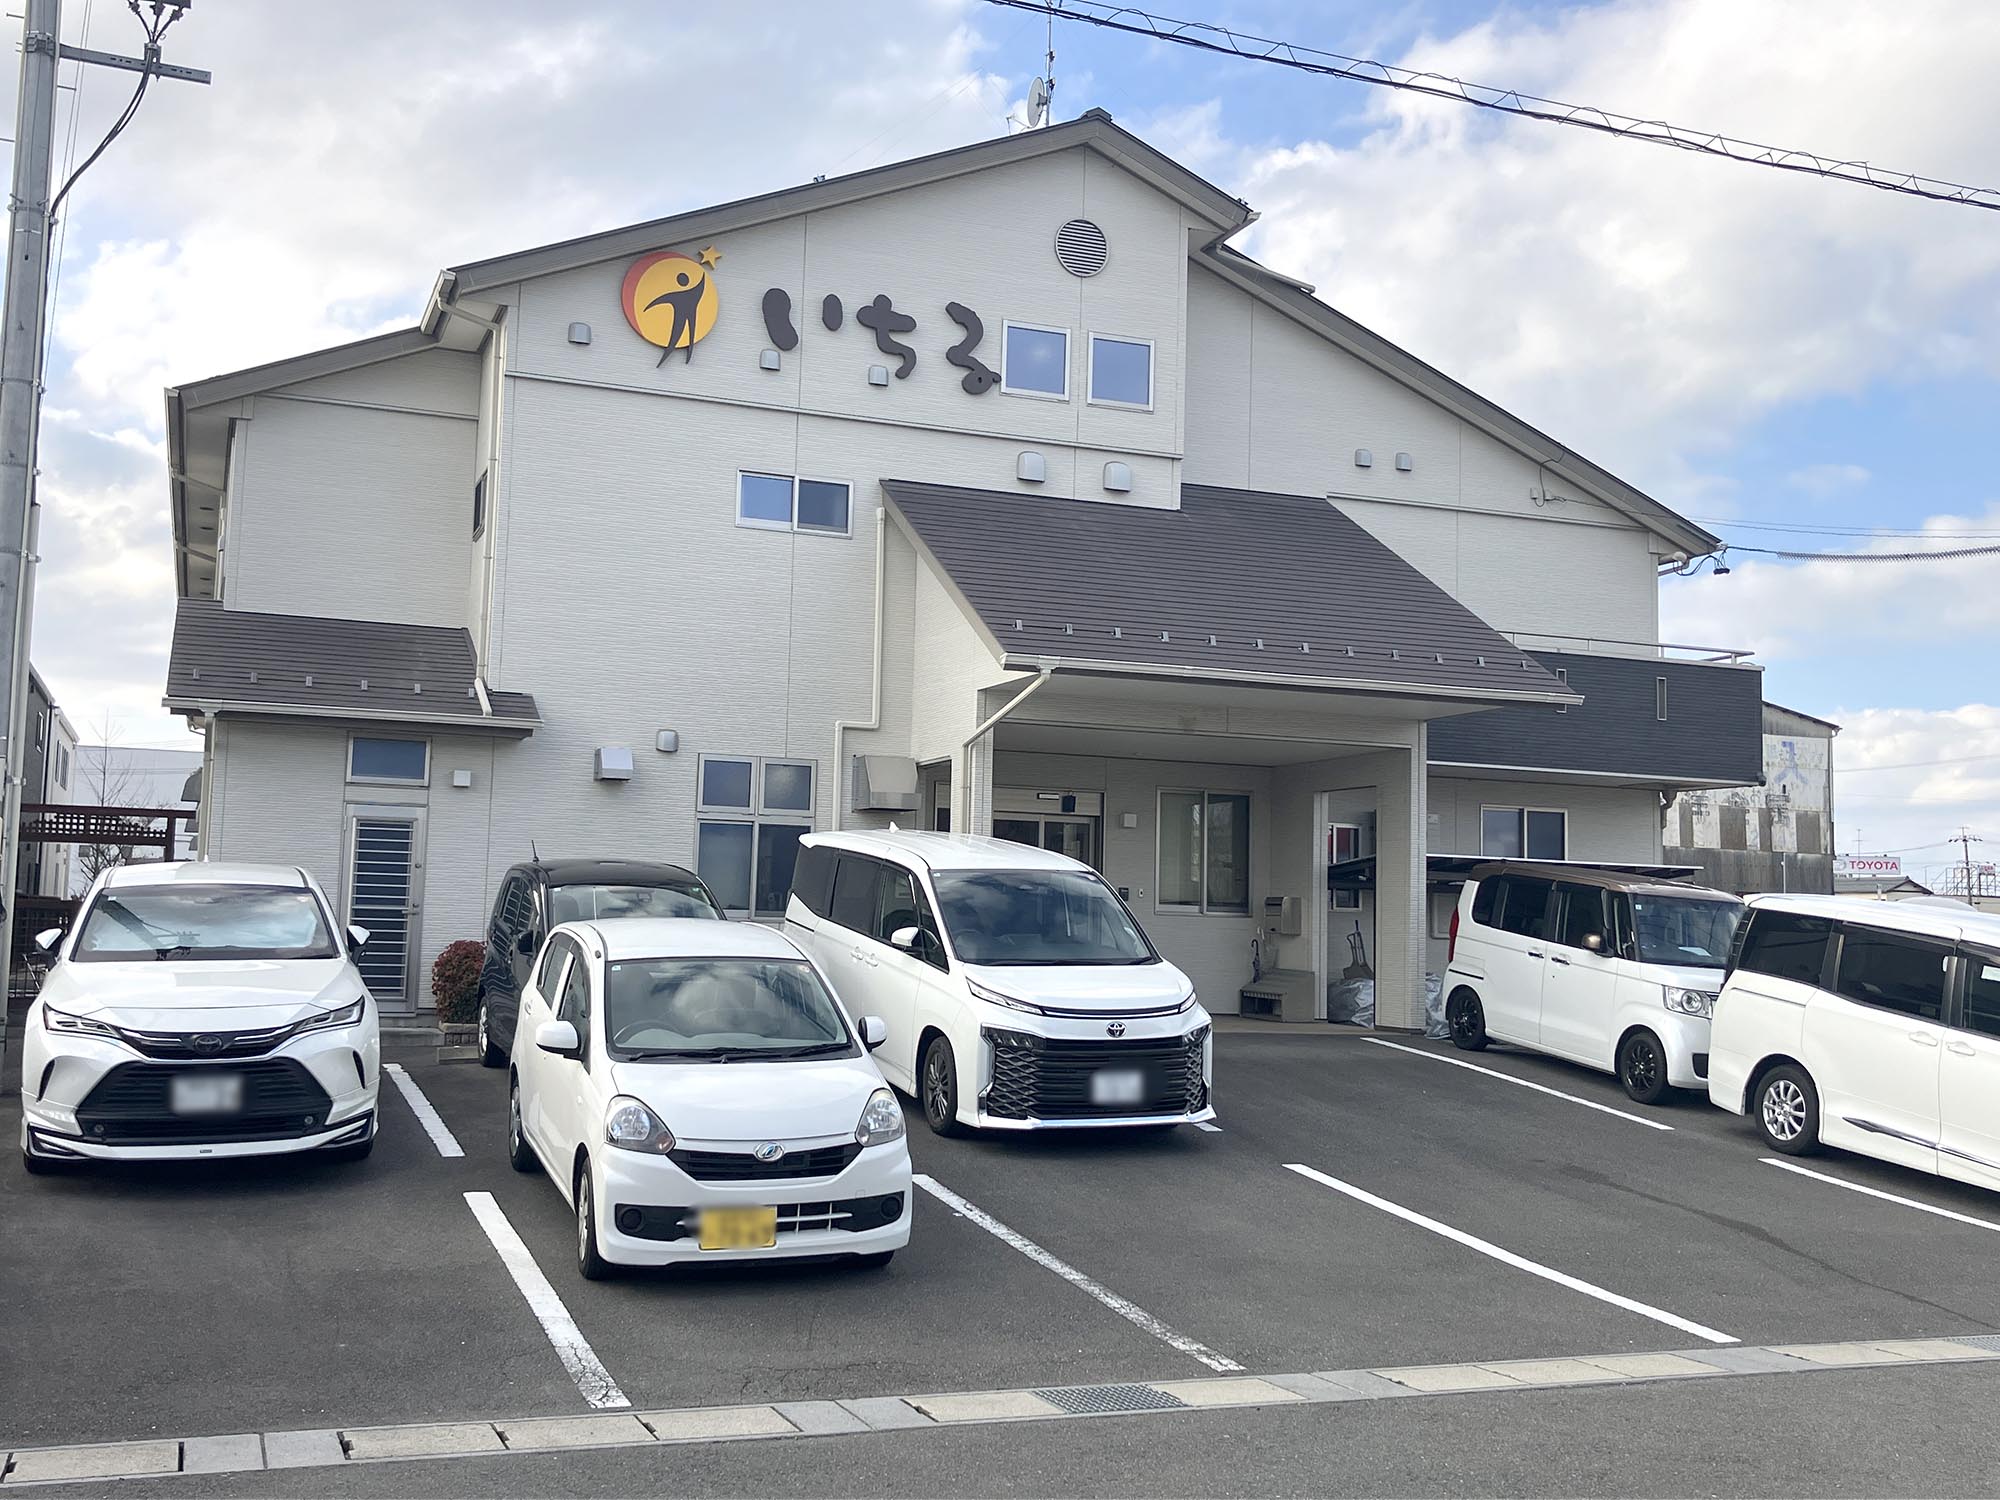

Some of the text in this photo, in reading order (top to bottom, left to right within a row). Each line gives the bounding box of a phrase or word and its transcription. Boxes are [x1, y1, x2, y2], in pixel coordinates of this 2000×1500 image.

[762, 288, 1001, 394] いちる
[1849, 860, 1898, 870] TOYOTA
